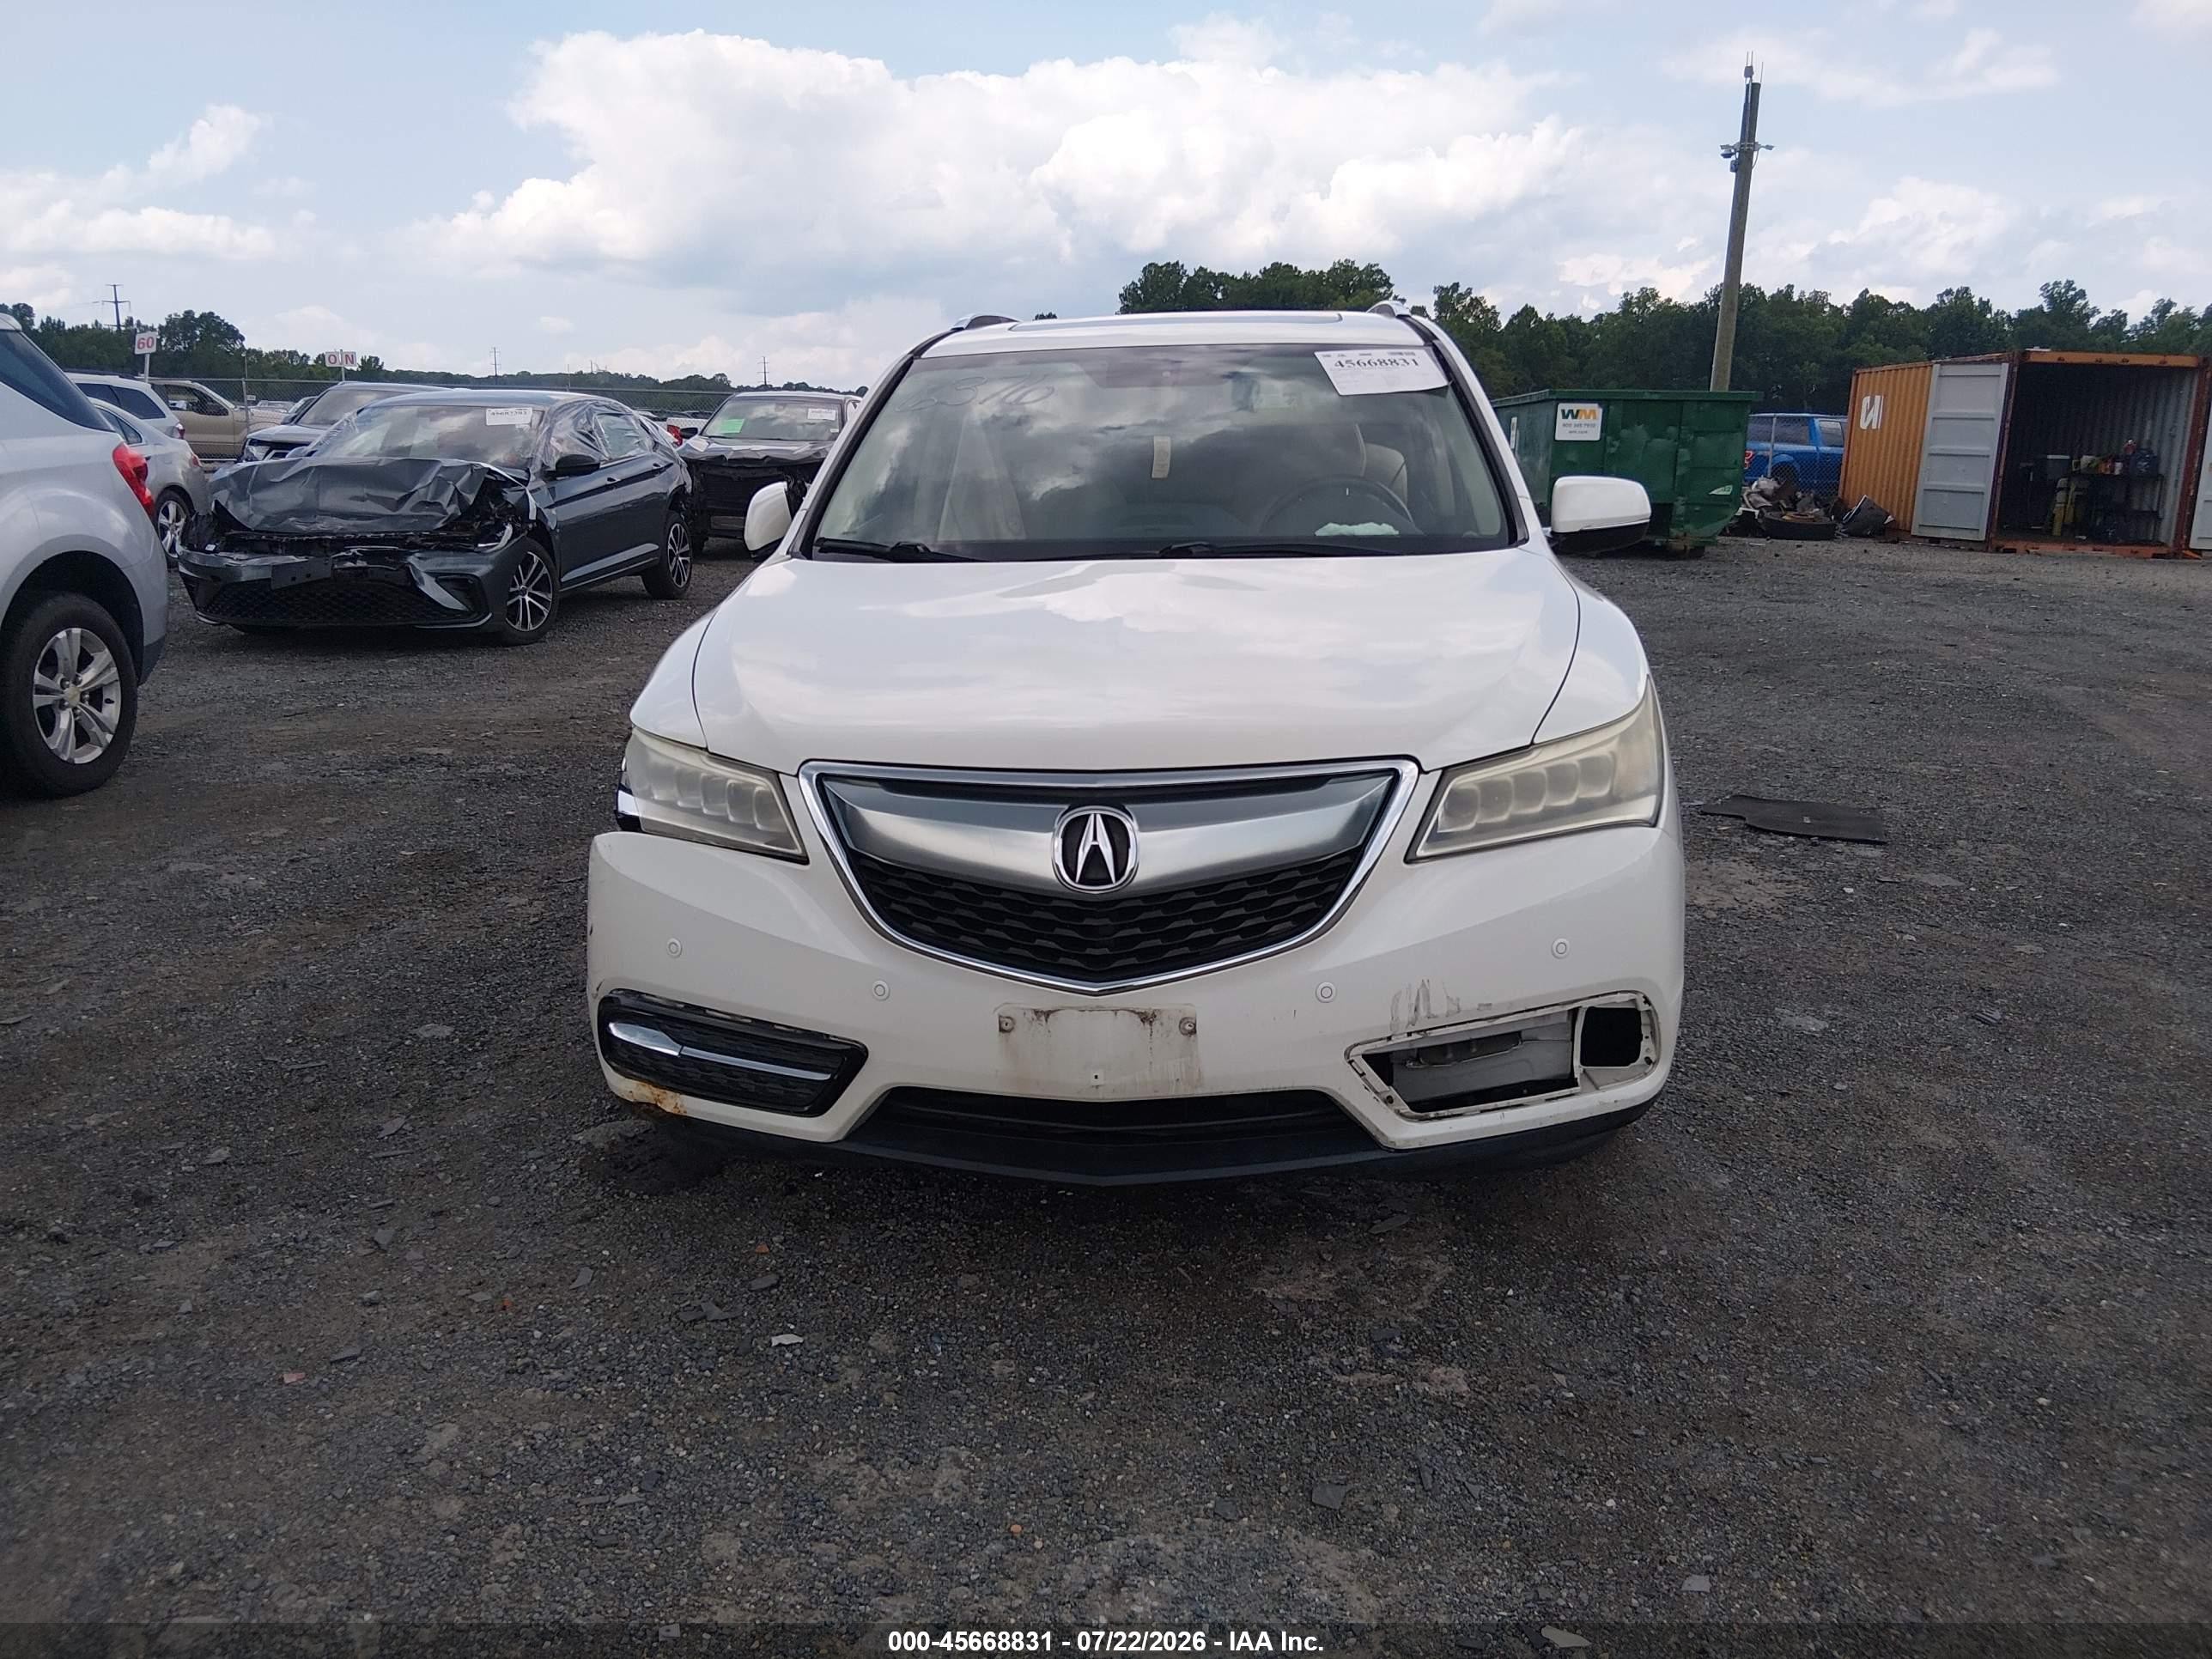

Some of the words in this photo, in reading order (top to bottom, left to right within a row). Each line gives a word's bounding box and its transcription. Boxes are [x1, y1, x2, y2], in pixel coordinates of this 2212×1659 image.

[137, 336, 155, 349] 60
[1334, 358, 1419, 368] 45668831
[1560, 408, 1597, 420] WM
